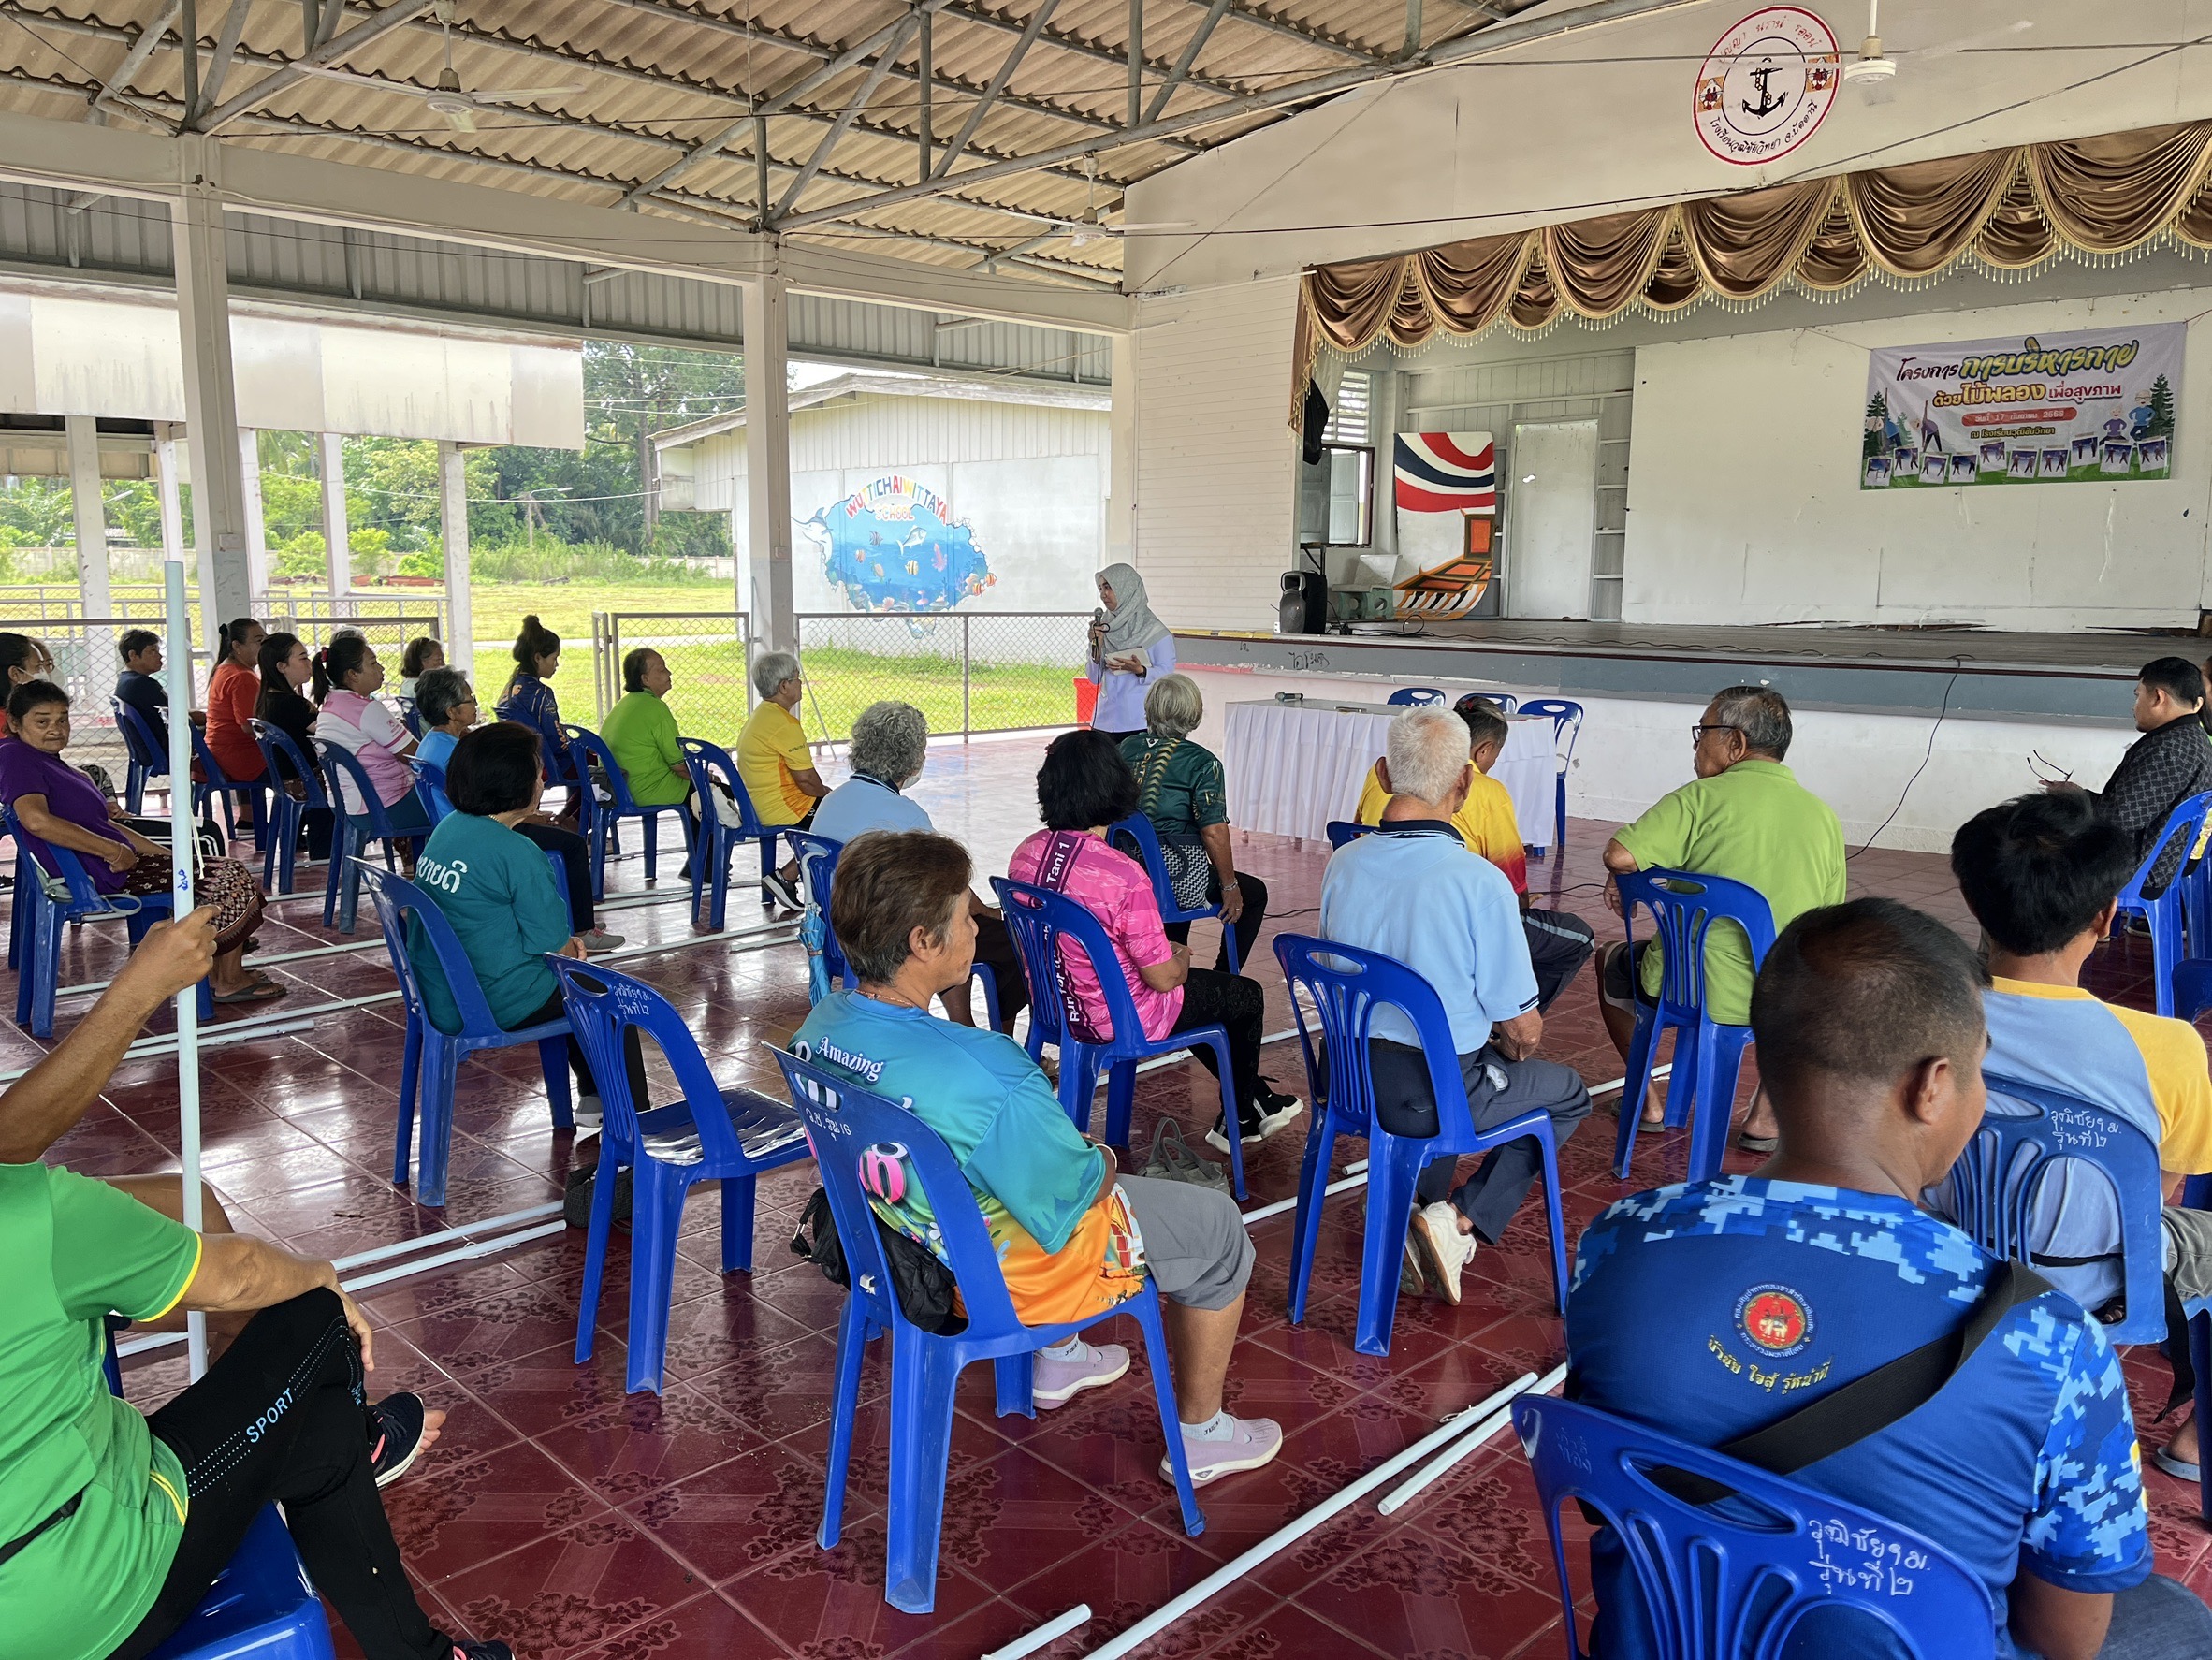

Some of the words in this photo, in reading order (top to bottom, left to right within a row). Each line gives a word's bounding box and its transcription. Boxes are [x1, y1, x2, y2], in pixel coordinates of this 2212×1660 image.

[876, 505, 914, 520] SCHOOL
[1046, 852, 1065, 883] Tani
[815, 1036, 884, 1082] Amazing
[245, 1387, 294, 1444] SPORT
